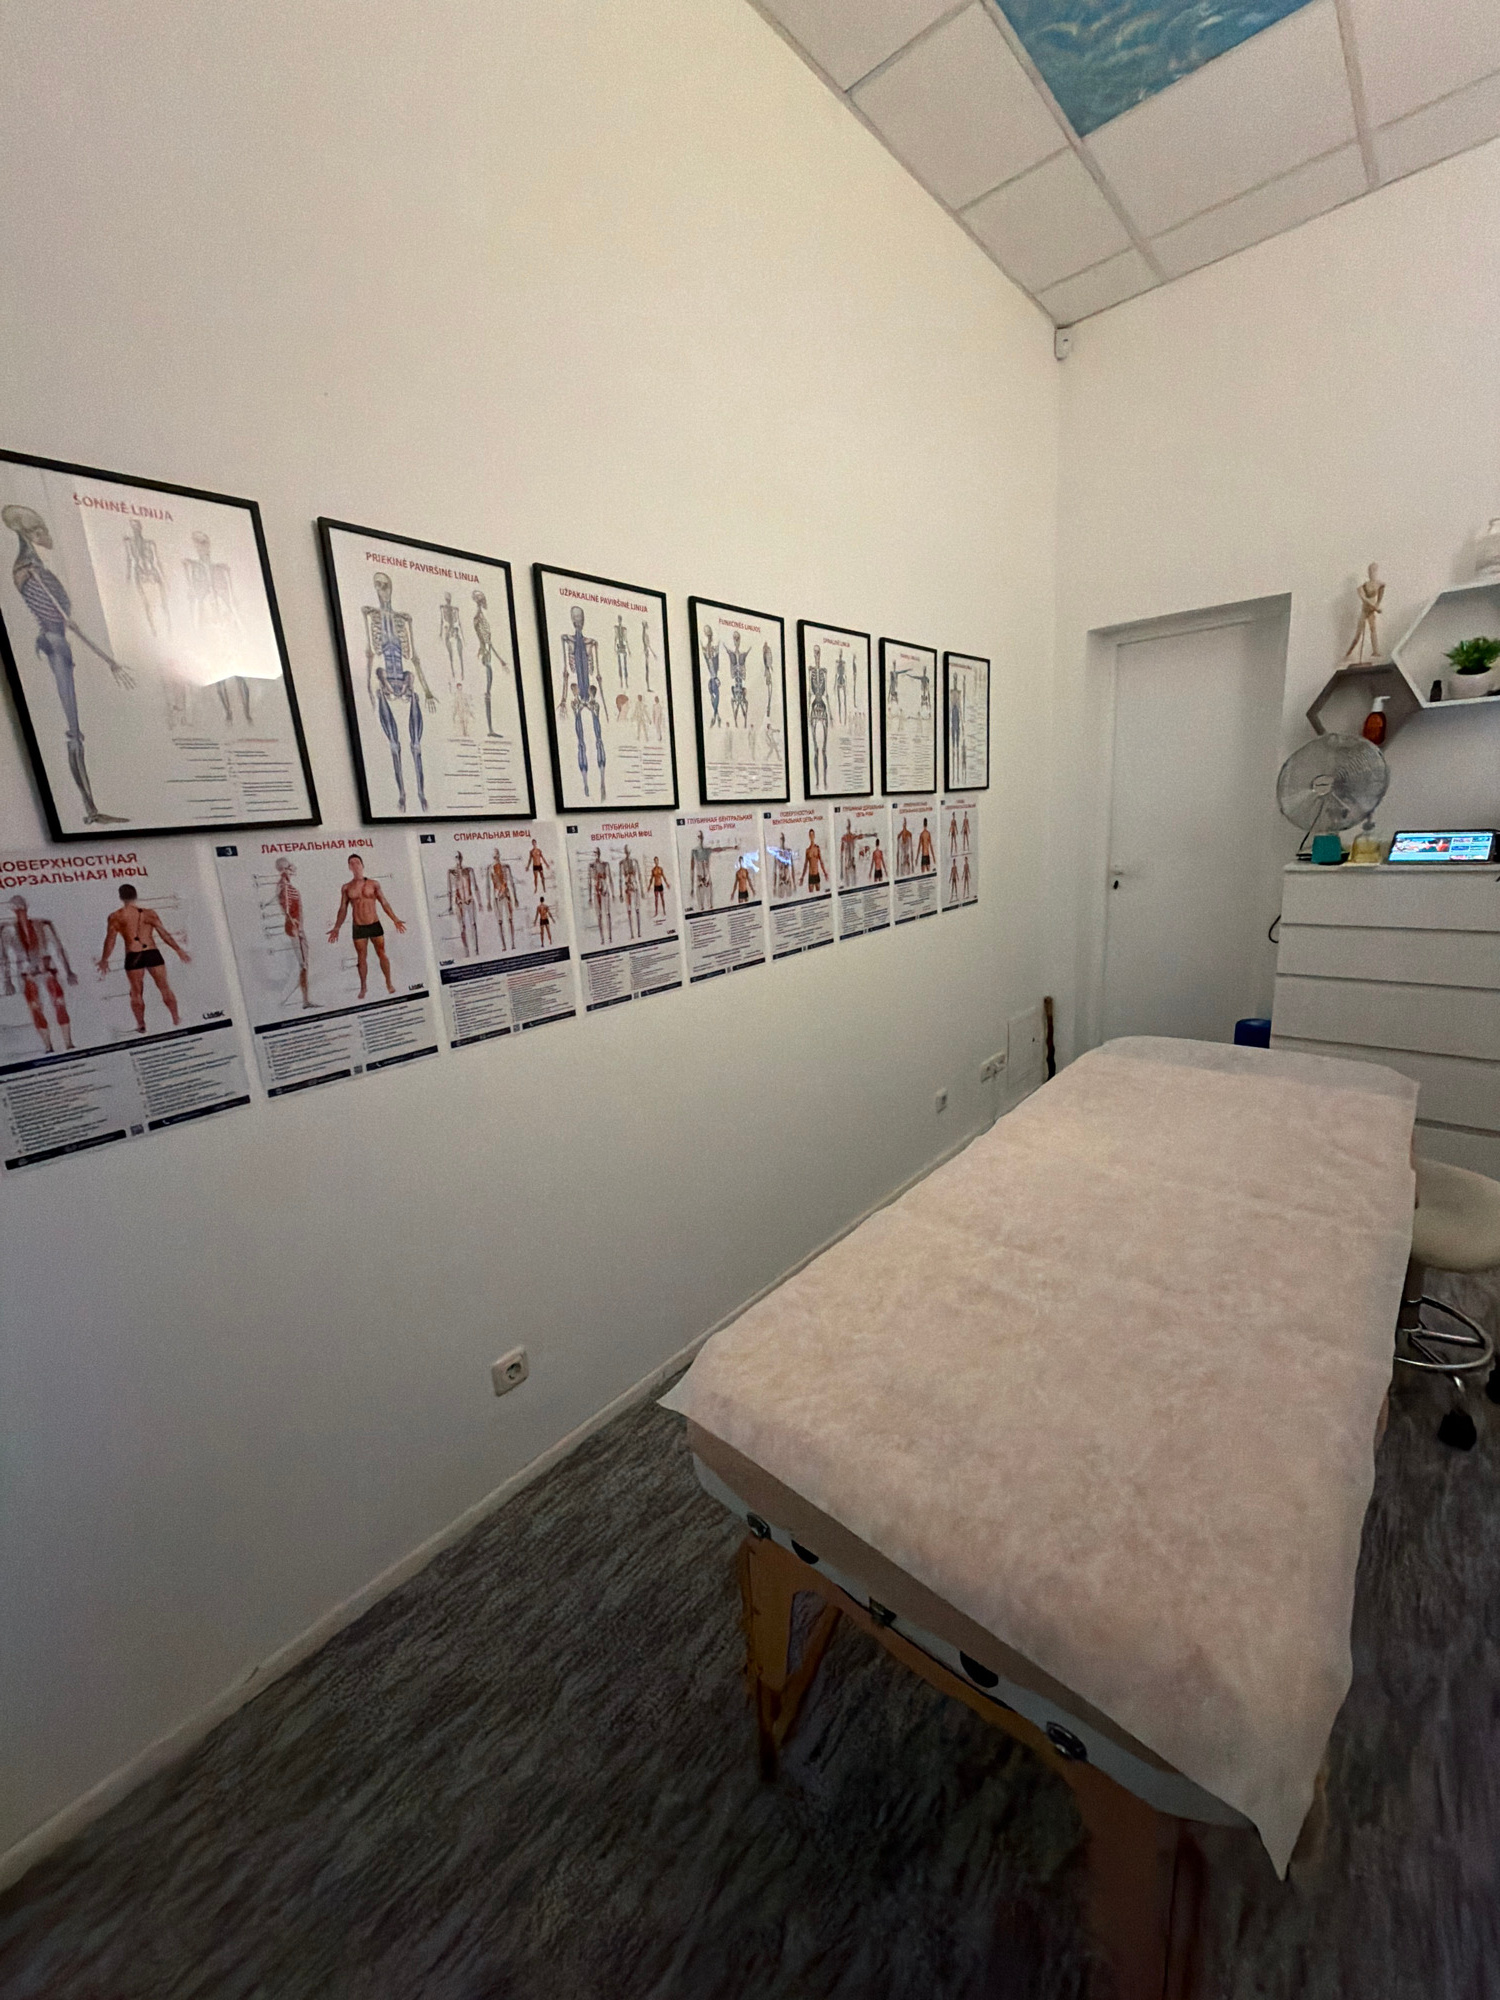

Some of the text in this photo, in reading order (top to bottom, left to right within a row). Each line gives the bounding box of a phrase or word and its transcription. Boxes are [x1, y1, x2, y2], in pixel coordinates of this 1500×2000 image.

[131, 504, 174, 522] LINIJA
[366, 552, 408, 568] PRIEKINĖ
[454, 570, 480, 583] LINIJA
[630, 603, 648, 612] LINIJA
[602, 822, 639, 831] ГЛУБИННАЯ
[454, 829, 532, 842] СПИРАЛЬНАЯ МФЦ
[590, 830, 653, 841] ВЕНТРАЛЬНАЯ МФЦ
[261, 838, 374, 854] ЛАТЕРАЛЬНАЯ МФЦ
[0, 852, 138, 873] ОВЕРХНОСТНАЯ
[112, 866, 148, 879] МФЦ
